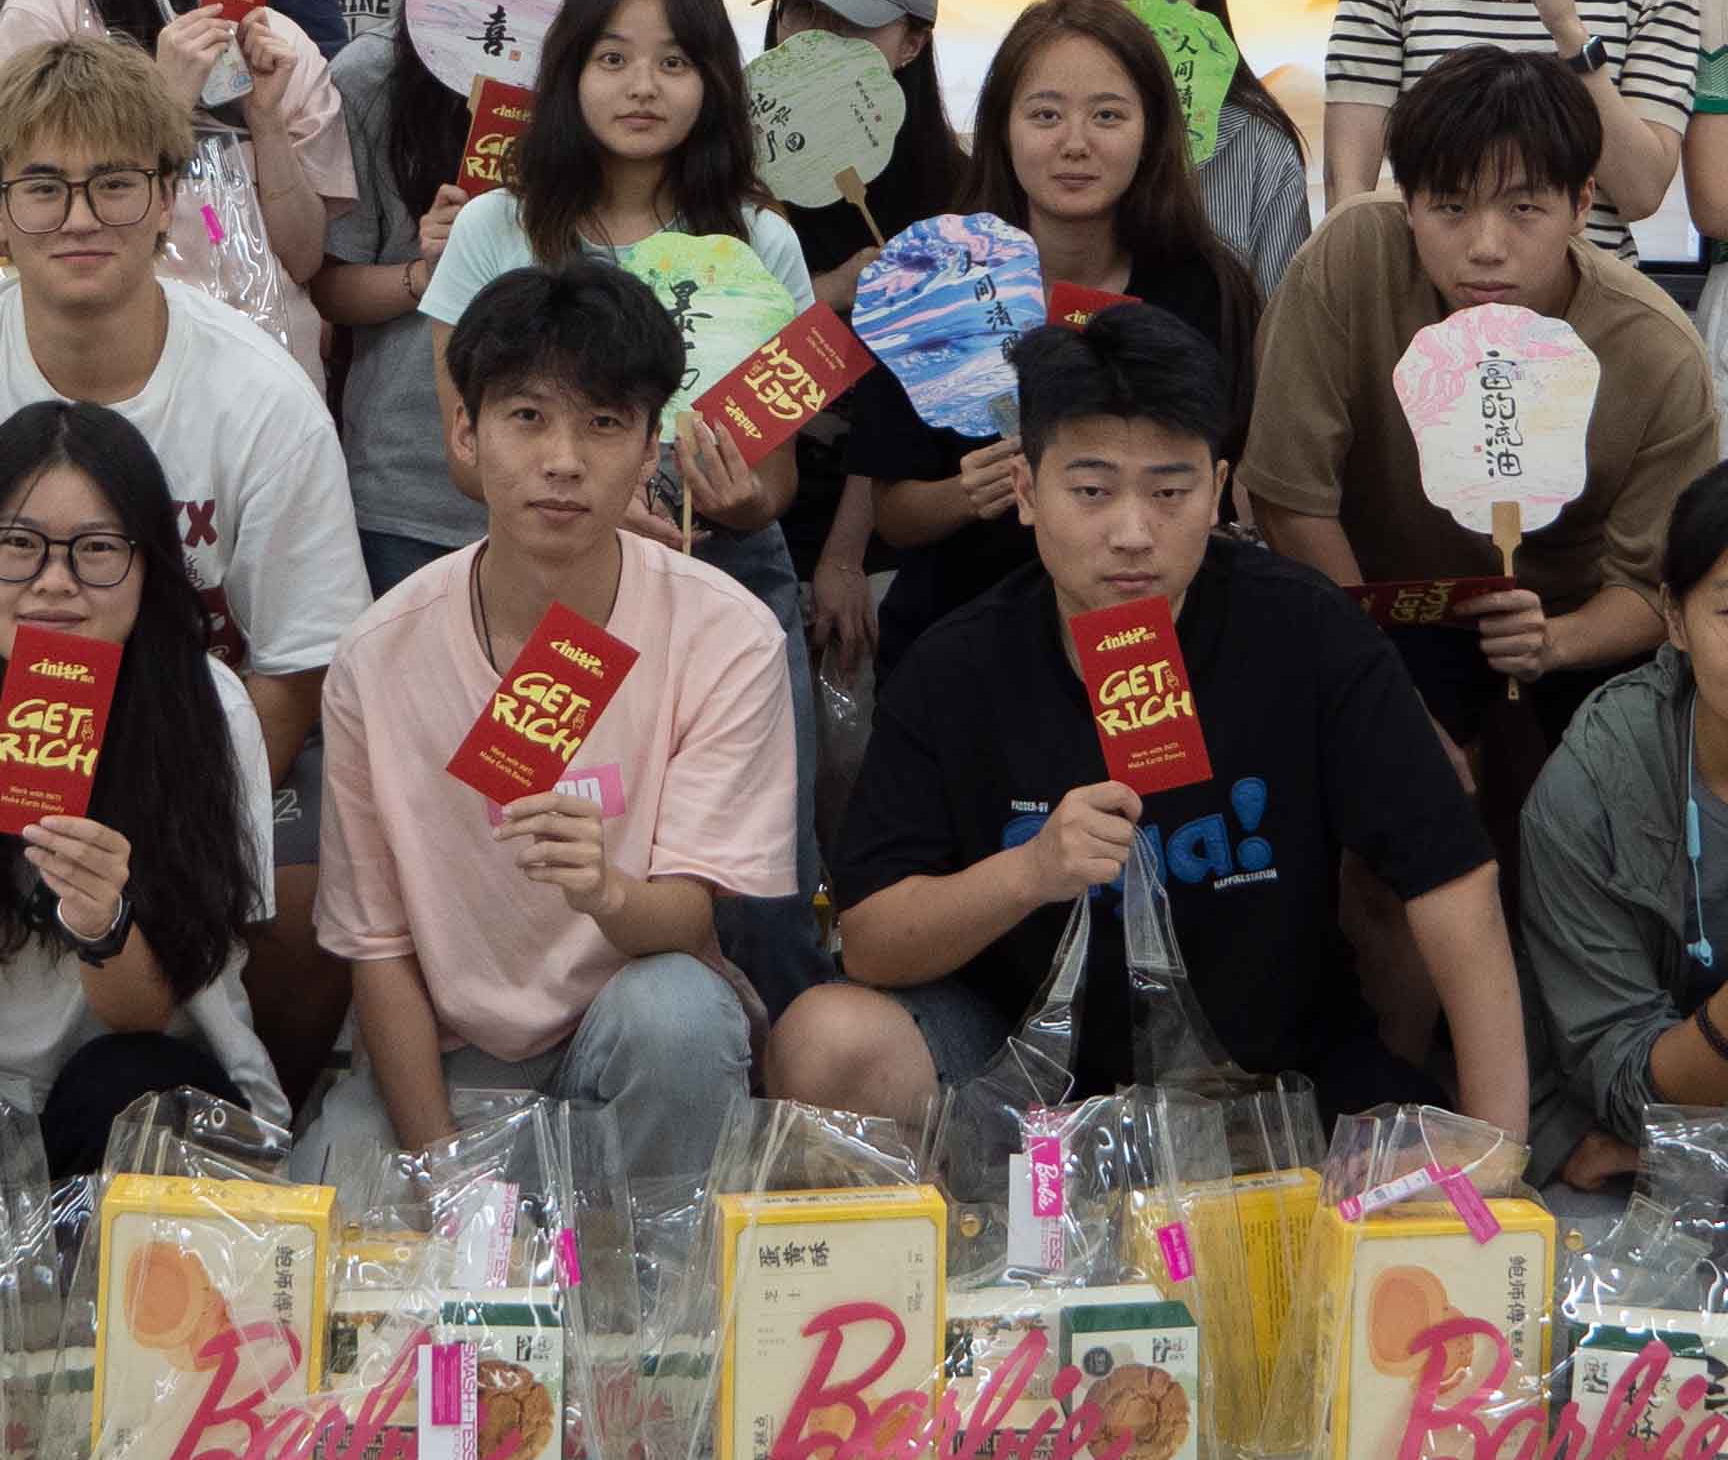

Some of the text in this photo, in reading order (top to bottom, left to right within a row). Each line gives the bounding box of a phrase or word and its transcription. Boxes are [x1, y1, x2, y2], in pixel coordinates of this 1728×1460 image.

[742, 369, 803, 420] GET
[760, 336, 826, 412] RICH
[512, 672, 591, 722] GET
[1098, 659, 1169, 705] GET
[7, 698, 93, 740] GET
[491, 692, 581, 762] RICH
[1095, 690, 1193, 736] RICH
[1034, 1162, 1060, 1211] Barbie
[759, 1240, 830, 1268] 蛋黄酥
